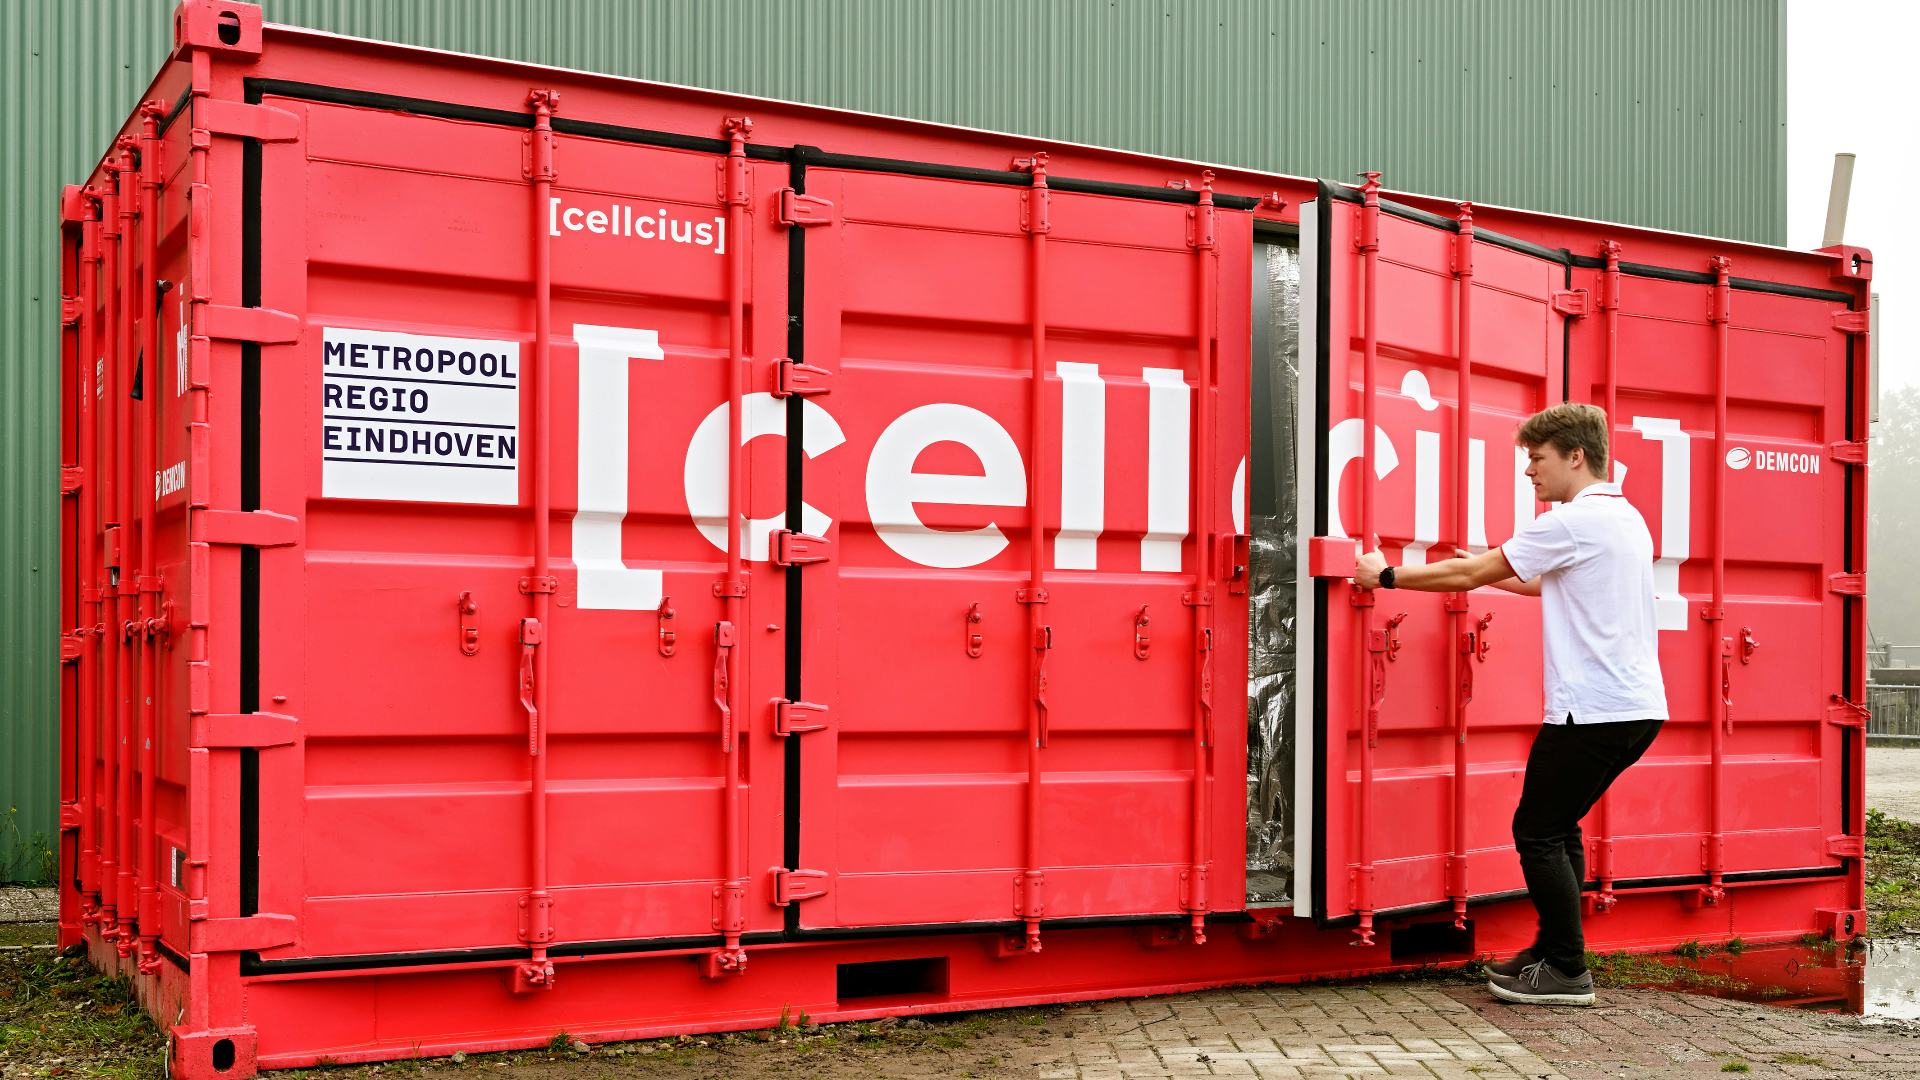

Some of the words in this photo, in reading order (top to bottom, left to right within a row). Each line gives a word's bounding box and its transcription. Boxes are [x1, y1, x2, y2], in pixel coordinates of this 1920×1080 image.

[549, 197, 726, 255] [cellcius]
[323, 341, 517, 379] METROPOOL
[323, 383, 429, 414] REGIO
[323, 425, 516, 460] EINDHOVEN
[162, 461, 185, 497] DEMCON
[572, 323, 1691, 632] [cellciu]
[1755, 450, 1820, 474] DEMCON
